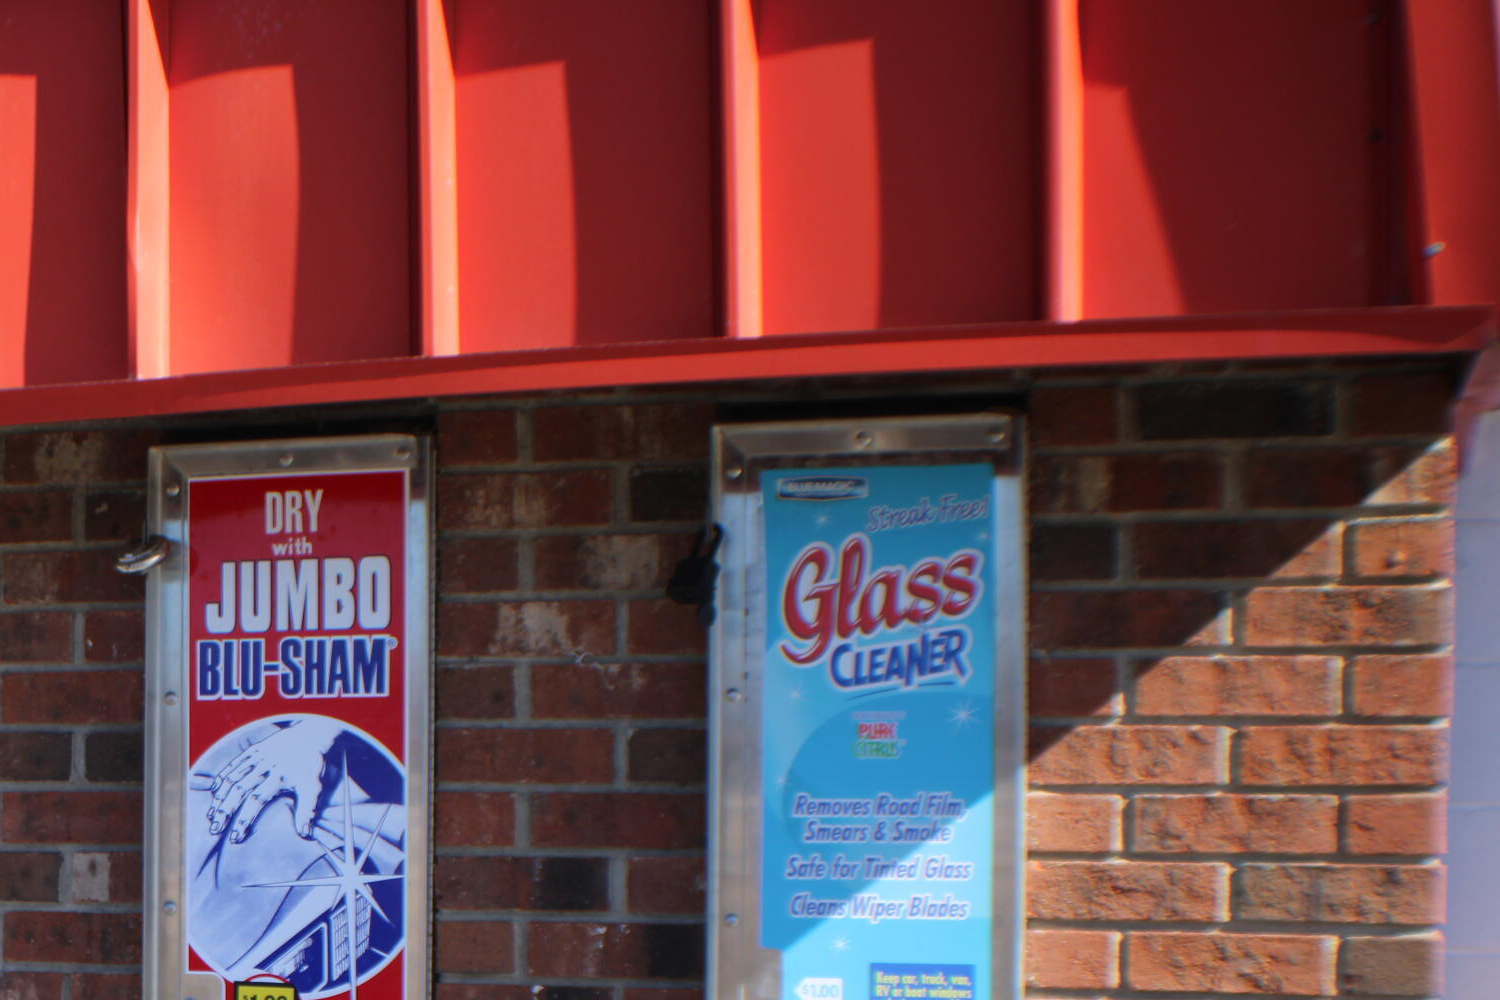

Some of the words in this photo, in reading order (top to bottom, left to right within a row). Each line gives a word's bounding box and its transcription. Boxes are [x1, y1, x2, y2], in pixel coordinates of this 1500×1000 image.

[265, 489, 323, 534] DRY
[868, 498, 933, 532] Streak
[272, 537, 313, 556] with
[205, 555, 391, 634] JUMBO
[778, 532, 986, 668] Glass
[830, 625, 973, 689] CLEANER
[792, 793, 870, 817] Removes
[875, 792, 923, 817] Road
[804, 820, 868, 843] Smears
[873, 820, 887, 843] &
[891, 819, 953, 843] Smoke
[786, 855, 827, 880] Safe
[831, 856, 860, 880] for
[863, 856, 918, 880] Tinted
[924, 857, 972, 880] Glass
[789, 892, 847, 918] Cleans
[851, 893, 904, 923] Wiper
[908, 894, 969, 919] Blades
[802, 984, 840, 998] $1.00
[877, 971, 900, 986] Keep
[930, 985, 972, 998] windows
